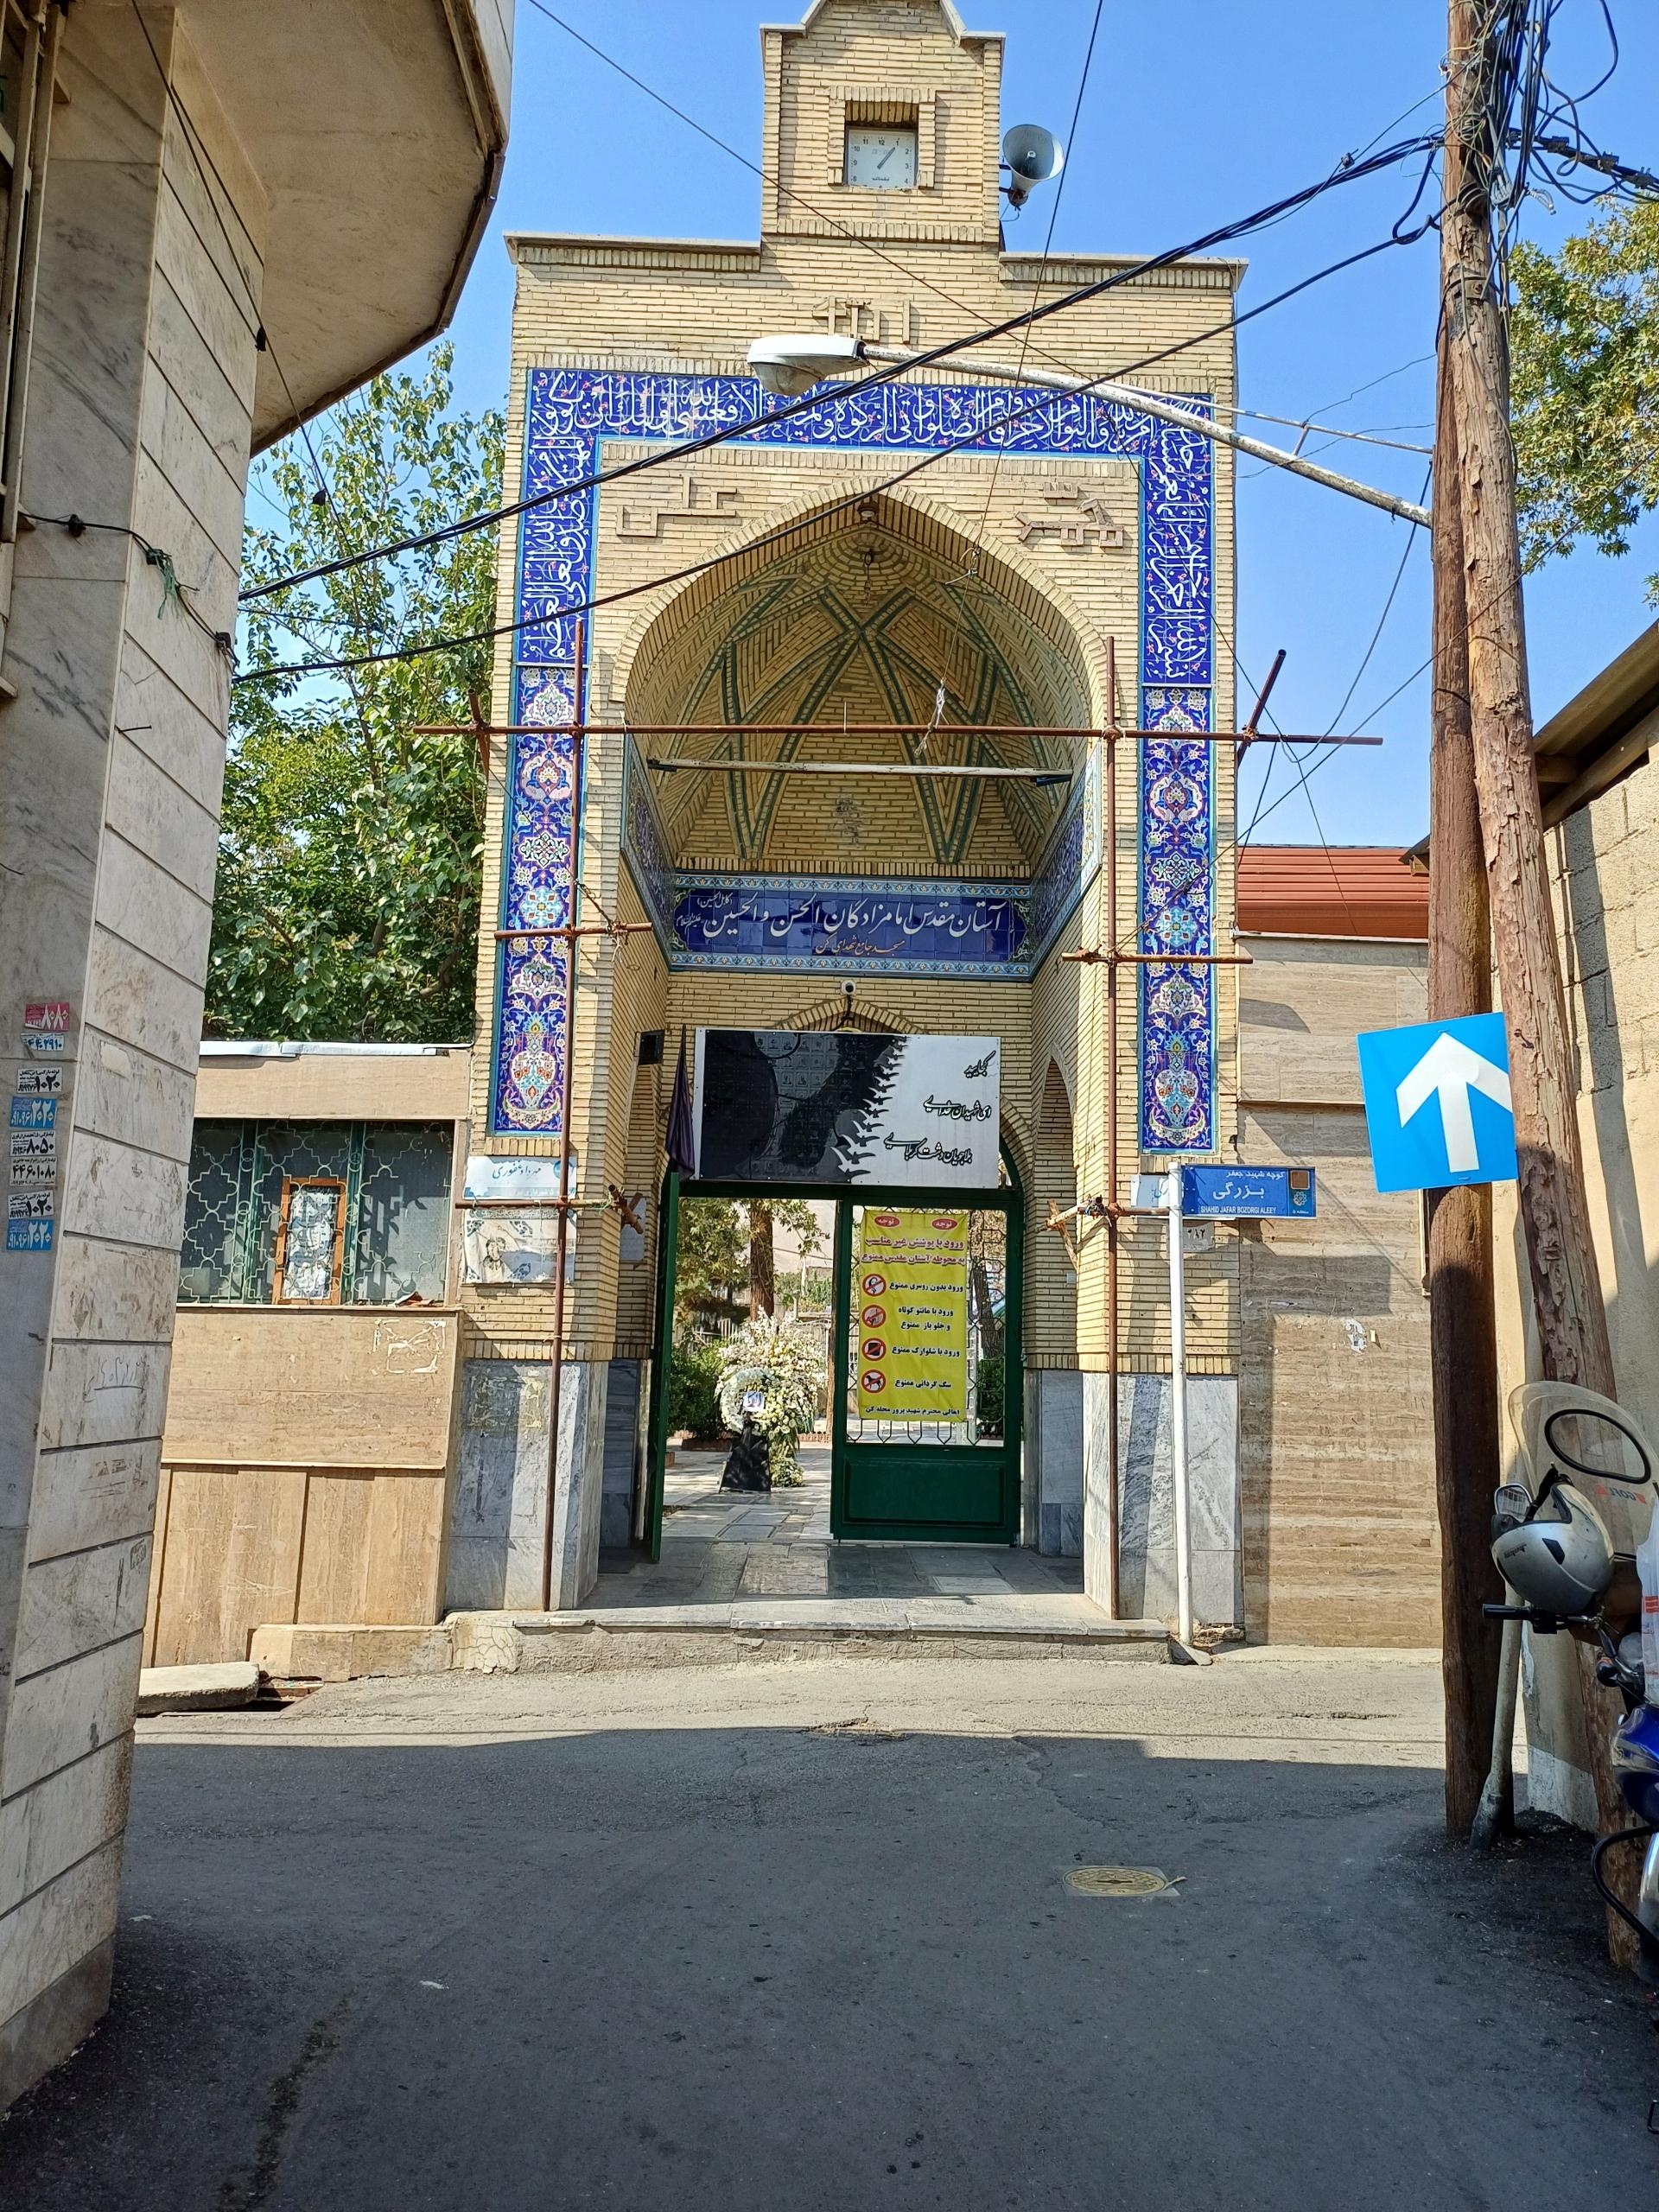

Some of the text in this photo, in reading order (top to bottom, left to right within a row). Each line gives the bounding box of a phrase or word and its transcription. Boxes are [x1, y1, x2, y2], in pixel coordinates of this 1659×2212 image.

[702, 891, 758, 938] الحسین
[760, 910, 770, 922] و
[770, 892, 818, 938] الحسن
[903, 900, 955, 935] مقدس
[949, 899, 1007, 938] آستان
[815, 931, 906, 957] مسجد جامع شهدای کن
[41, 1003, 68, 1031] ۸۰۸۰
[35, 1074, 60, 1093] ۱۰۲۰
[31, 1100, 54, 1127] ۲۰۲۰
[923, 1095, 992, 1122] ای شهیدان خدایی
[26, 1137, 54, 1154] ۸۰۵۰
[883, 1131, 973, 1166] بلاجویان دشت کربلایی
[12, 1164, 55, 1179] ۴۴۶۰۱۰۸۰
[1226, 1169, 1286, 1181] کوچه شهید جعفر
[1212, 1181, 1265, 1200] بزرگی
[26, 1198, 53, 1217] ۱۰۲۰
[877, 1217, 894, 1225] توجه
[28, 1221, 52, 1249] ۲۰۲۰
[865, 1236, 892, 1245] مناسب
[893, 1237, 906, 1247] غیر
[944, 1240, 964, 1250] ورود
[861, 1253, 883, 1262] ممنوع
[884, 1254, 907, 1262] مقدس
[908, 1254, 930, 1263] آستان
[932, 1255, 957, 1265] محوطه
[889, 1281, 908, 1290] ممنوع
[898, 1306, 914, 1315] کوتاه
[916, 1306, 931, 1316] مانتو
[938, 1308, 954, 1317] ورود
[900, 1321, 920, 1330] ممنوع
[923, 1321, 931, 1331] باز
[933, 1321, 944, 1331] جلو
[911, 1347, 936, 1356] شلوارک
[944, 1349, 960, 1357] ورود
[915, 1380, 938, 1389] گردانی
